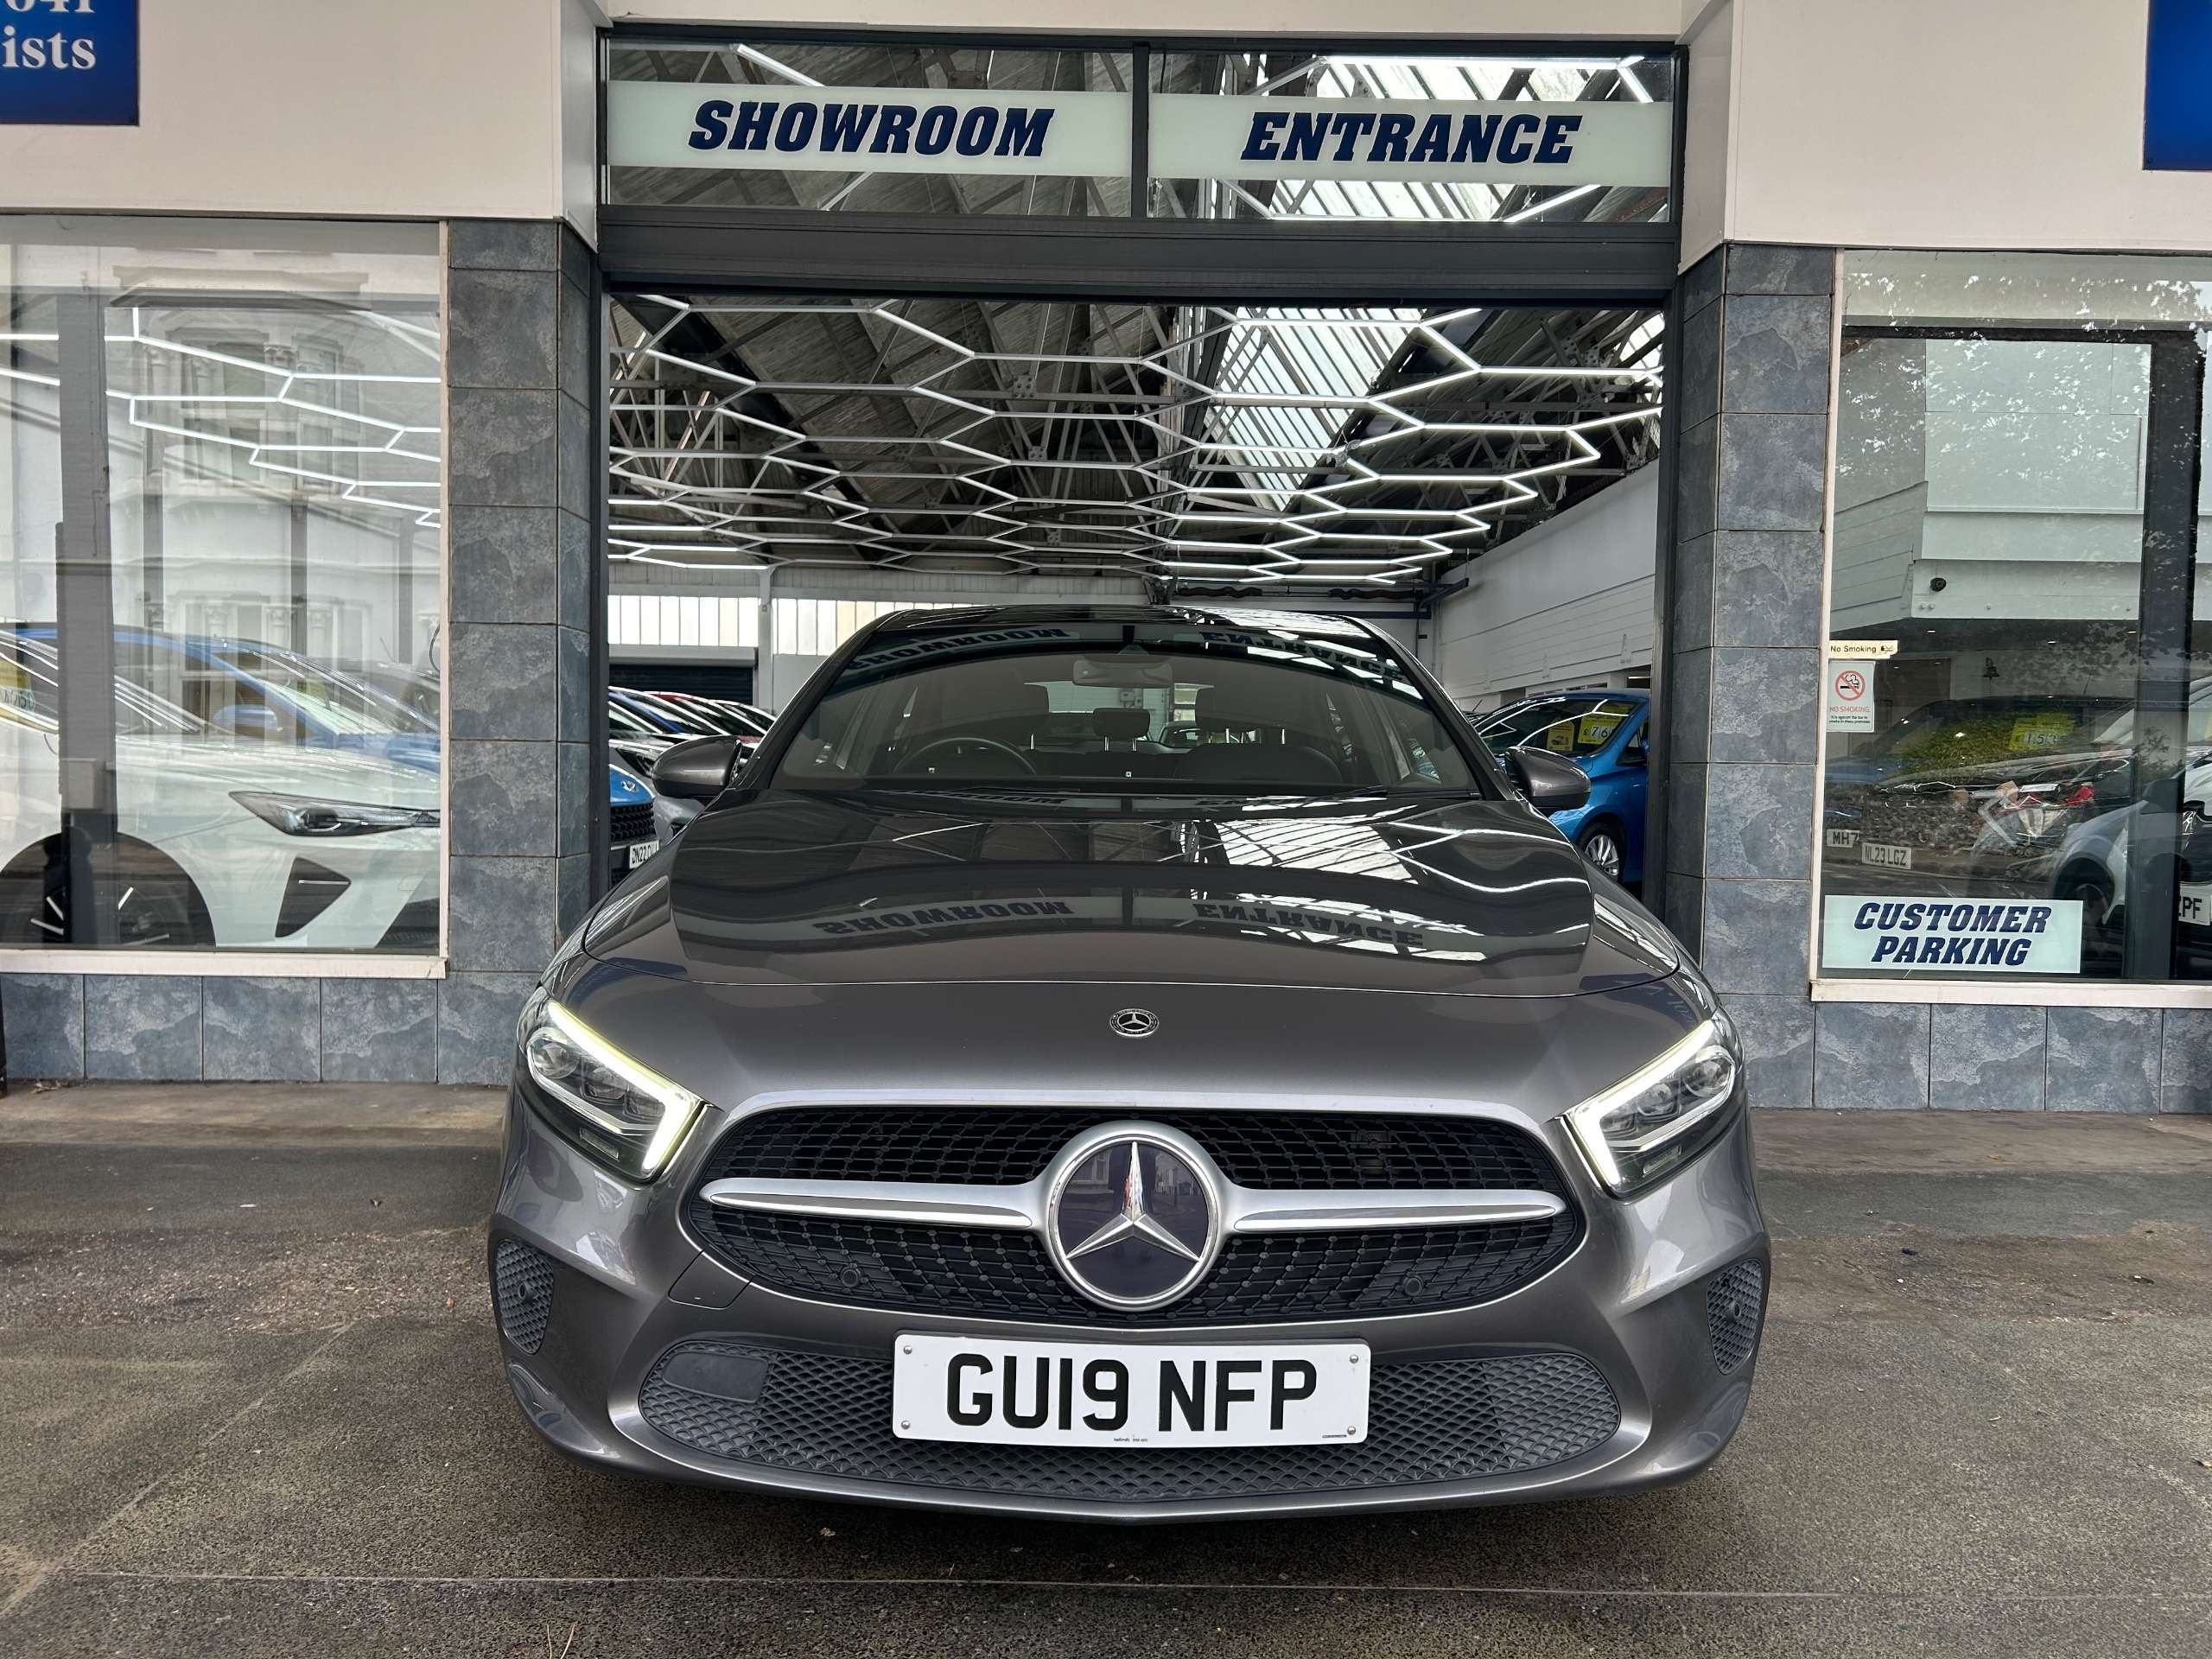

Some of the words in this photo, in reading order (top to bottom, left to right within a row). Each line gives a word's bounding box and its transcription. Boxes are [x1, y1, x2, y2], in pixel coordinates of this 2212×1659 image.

[688, 99, 1055, 157] SHOWROOM
[1239, 111, 1583, 164] ENTRANCE
[1853, 902, 2052, 933] CUSTOMER
[2178, 896, 2202, 918] PF
[1871, 936, 2032, 966] PARKING
[947, 1353, 1129, 1431] GU19
[1158, 1359, 1318, 1432] NFP
